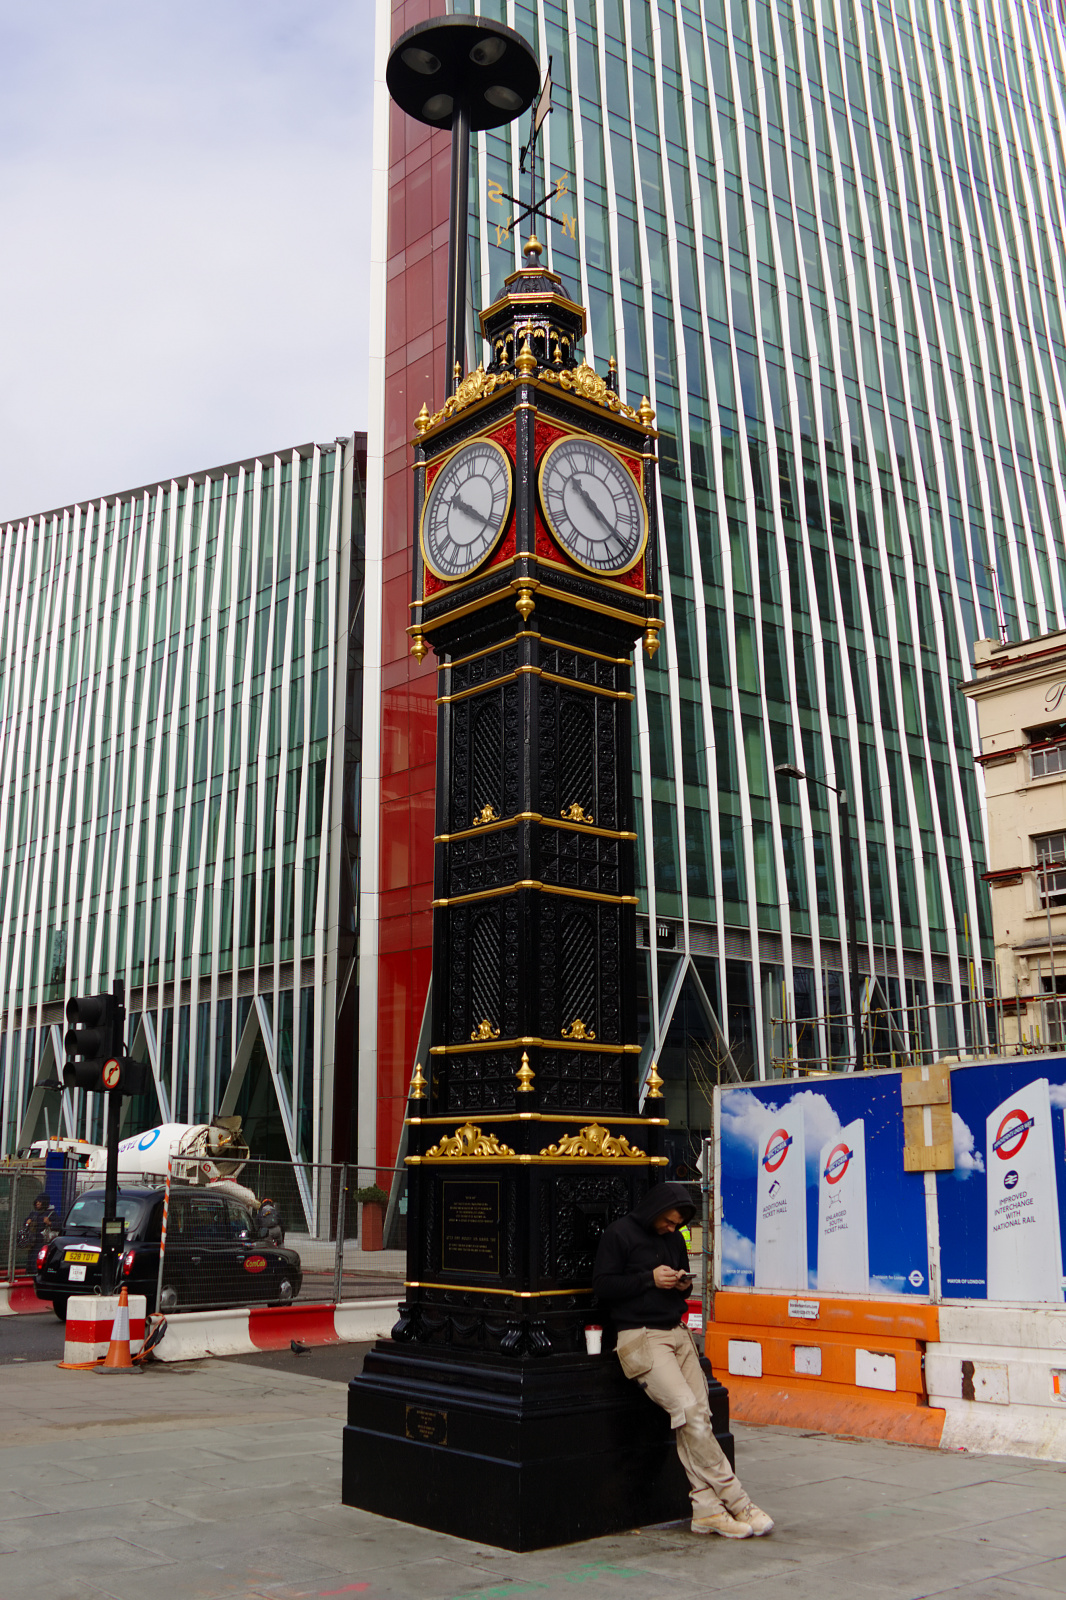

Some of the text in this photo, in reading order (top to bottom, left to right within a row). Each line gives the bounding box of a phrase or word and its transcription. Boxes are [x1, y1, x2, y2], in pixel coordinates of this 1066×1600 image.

[555, 171, 568, 203] E
[561, 212, 576, 240] N
[466, 458, 475, 479] XII
[584, 454, 595, 475] XII
[489, 467, 502, 485] II
[551, 464, 568, 482] X
[493, 488, 506, 502] III
[612, 491, 626, 501] II
[616, 512, 632, 526] III
[999, 1191, 1027, 1205] IMPROVED
[763, 1199, 787, 1213] ADDITIONAL
[763, 1206, 787, 1219] TICKET HALL
[994, 1198, 1034, 1216] INTERCHANGE
[826, 1210, 846, 1222] ENLARGED
[1005, 1210, 1021, 1220] WITH
[829, 1218, 843, 1227] SOUTH
[993, 1216, 1036, 1232] NATIONAL RAIL
[824, 1225, 838, 1235] TICKET
[246, 1259, 266, 1267] ComCab
